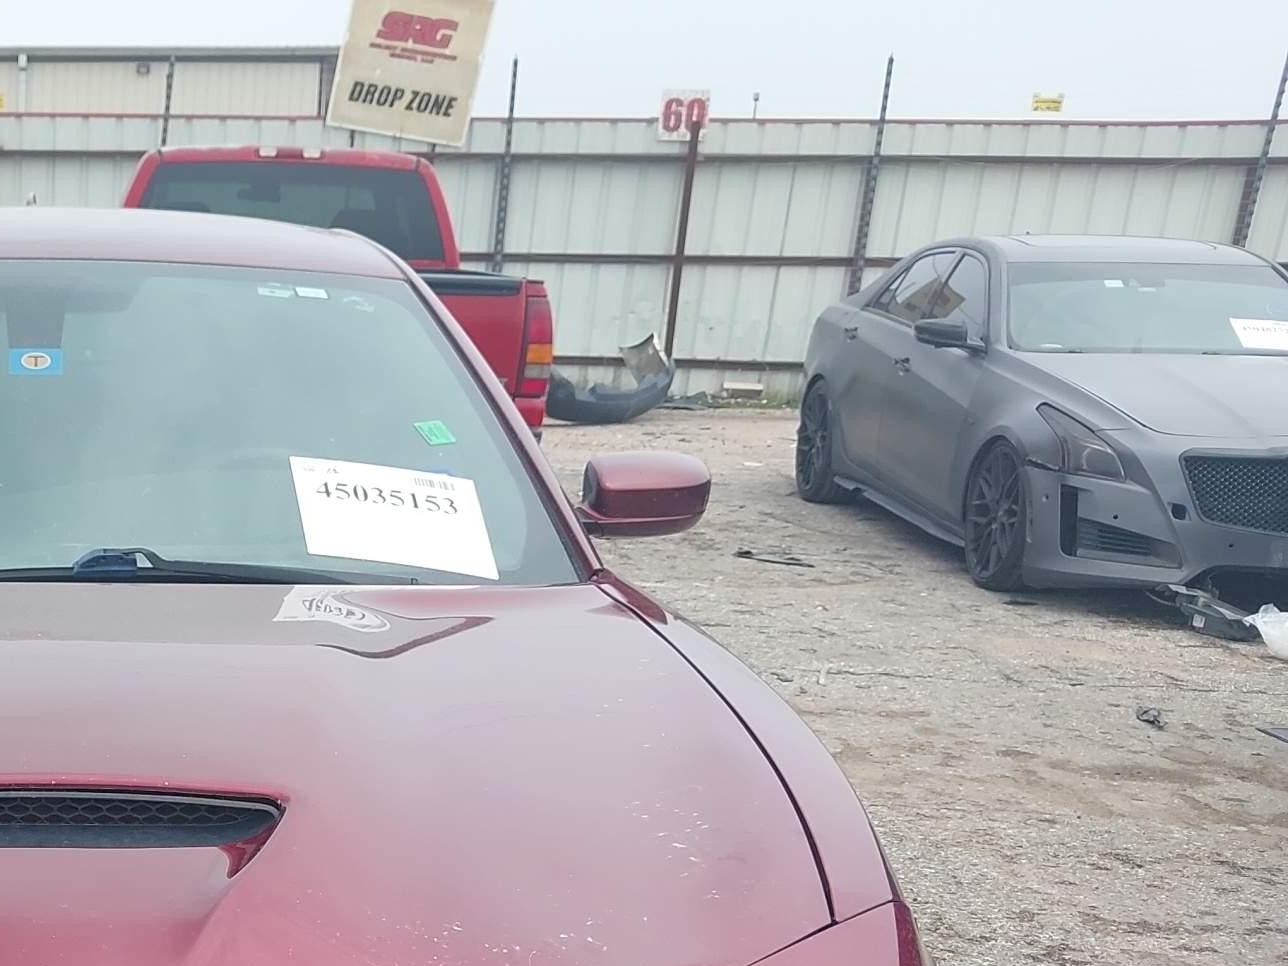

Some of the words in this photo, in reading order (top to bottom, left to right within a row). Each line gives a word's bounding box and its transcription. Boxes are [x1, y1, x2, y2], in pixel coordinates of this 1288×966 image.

[348, 81, 405, 108] DROP
[405, 90, 458, 117] ZONE
[663, 97, 706, 132] 60
[315, 481, 458, 515] 45035153
